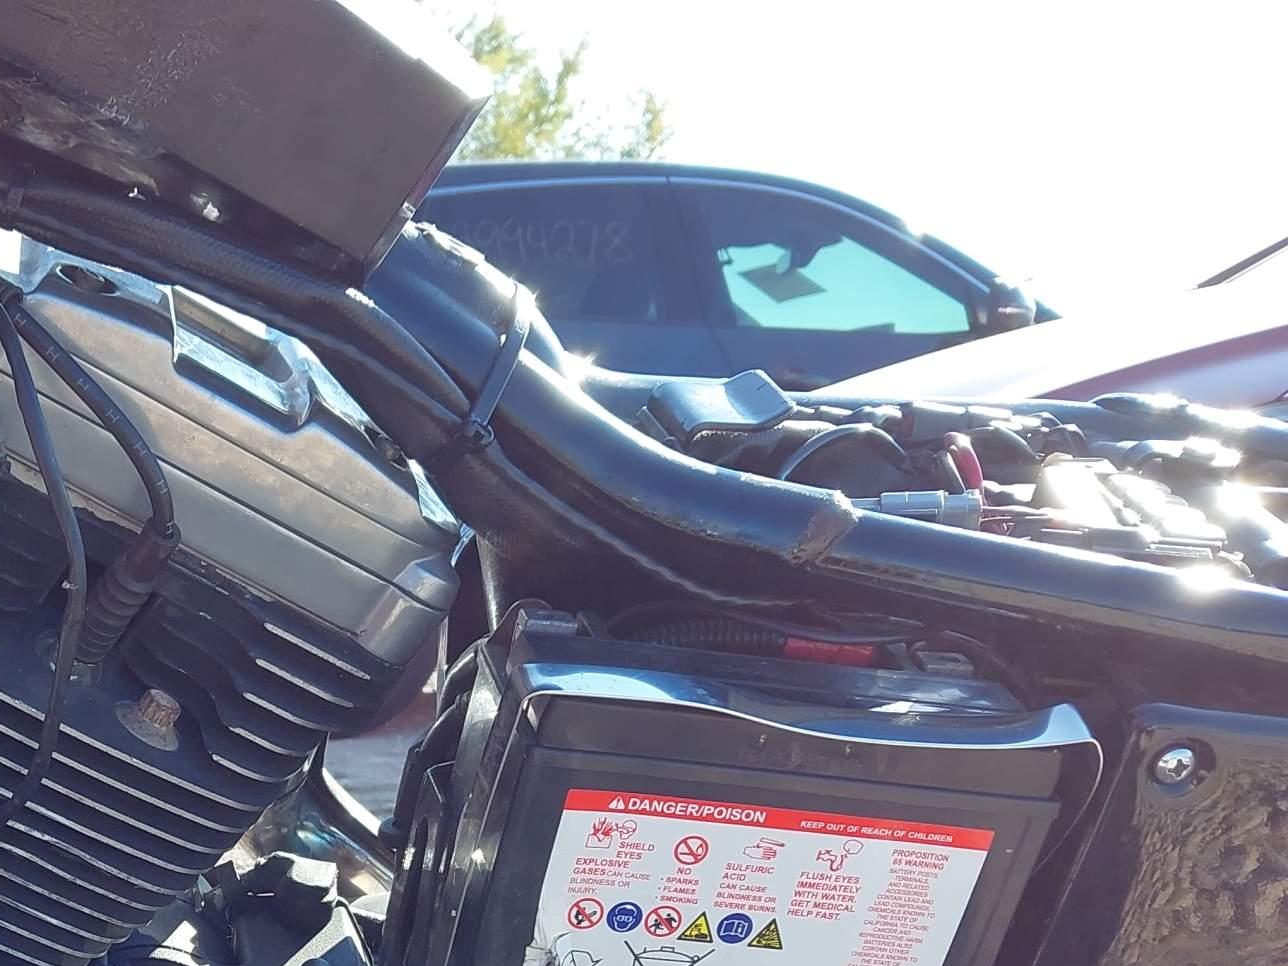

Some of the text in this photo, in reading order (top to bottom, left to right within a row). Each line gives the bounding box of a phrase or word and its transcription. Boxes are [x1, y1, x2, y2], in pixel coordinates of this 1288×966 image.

[628, 797, 767, 823] DANGER/POISON
[800, 821, 953, 843] KEEP OUT OF REACH OF CHILDREN
[619, 841, 655, 851] SHIELD
[616, 851, 642, 860] EYES
[892, 849, 950, 862] PROPOSITION
[575, 858, 630, 868] EXPLOSIVE
[725, 863, 775, 874] SULFURIC
[904, 859, 944, 870] WARNING
[573, 868, 651, 880] GASES CAN CAUSE
[722, 873, 746, 881] ACID
[800, 871, 861, 884] FLUSH EYES
[569, 878, 631, 888] BLINDNESS OR
[665, 876, 699, 886] SPARKS
[663, 886, 696, 895] FLAMES
[719, 882, 768, 893] CAN CAUSE
[796, 881, 861, 894] IMMEDIATELY
[660, 895, 698, 904] SMOKING
[716, 892, 777, 904] BLINDNESS OR
[794, 890, 819, 900] WITH
[713, 901, 746, 910] SEVERE
[790, 899, 855, 913] GET MEDICAL
[787, 908, 841, 920] HELP FAST.
